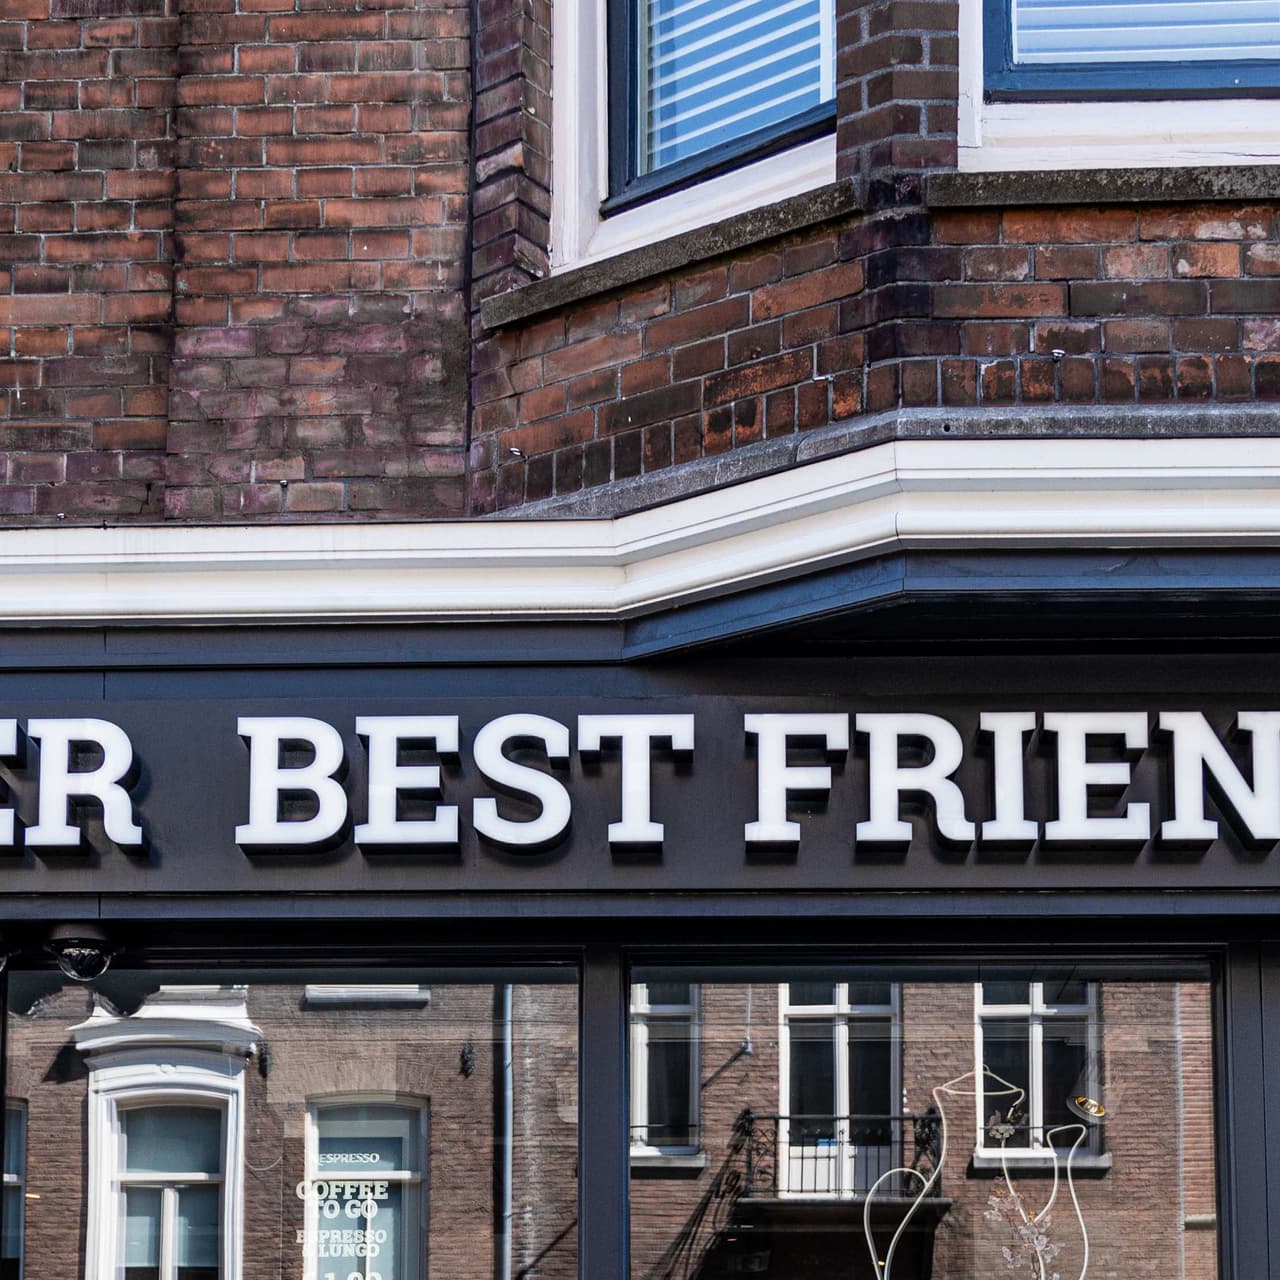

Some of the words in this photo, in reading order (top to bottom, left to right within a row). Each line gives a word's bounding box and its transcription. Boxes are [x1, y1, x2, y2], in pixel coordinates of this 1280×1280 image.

[234, 712, 694, 847] BEST
[296, 1180, 389, 1200] COFFEE
[345, 1200, 378, 1219] GO
[319, 1243, 380, 1257] LUNGO
